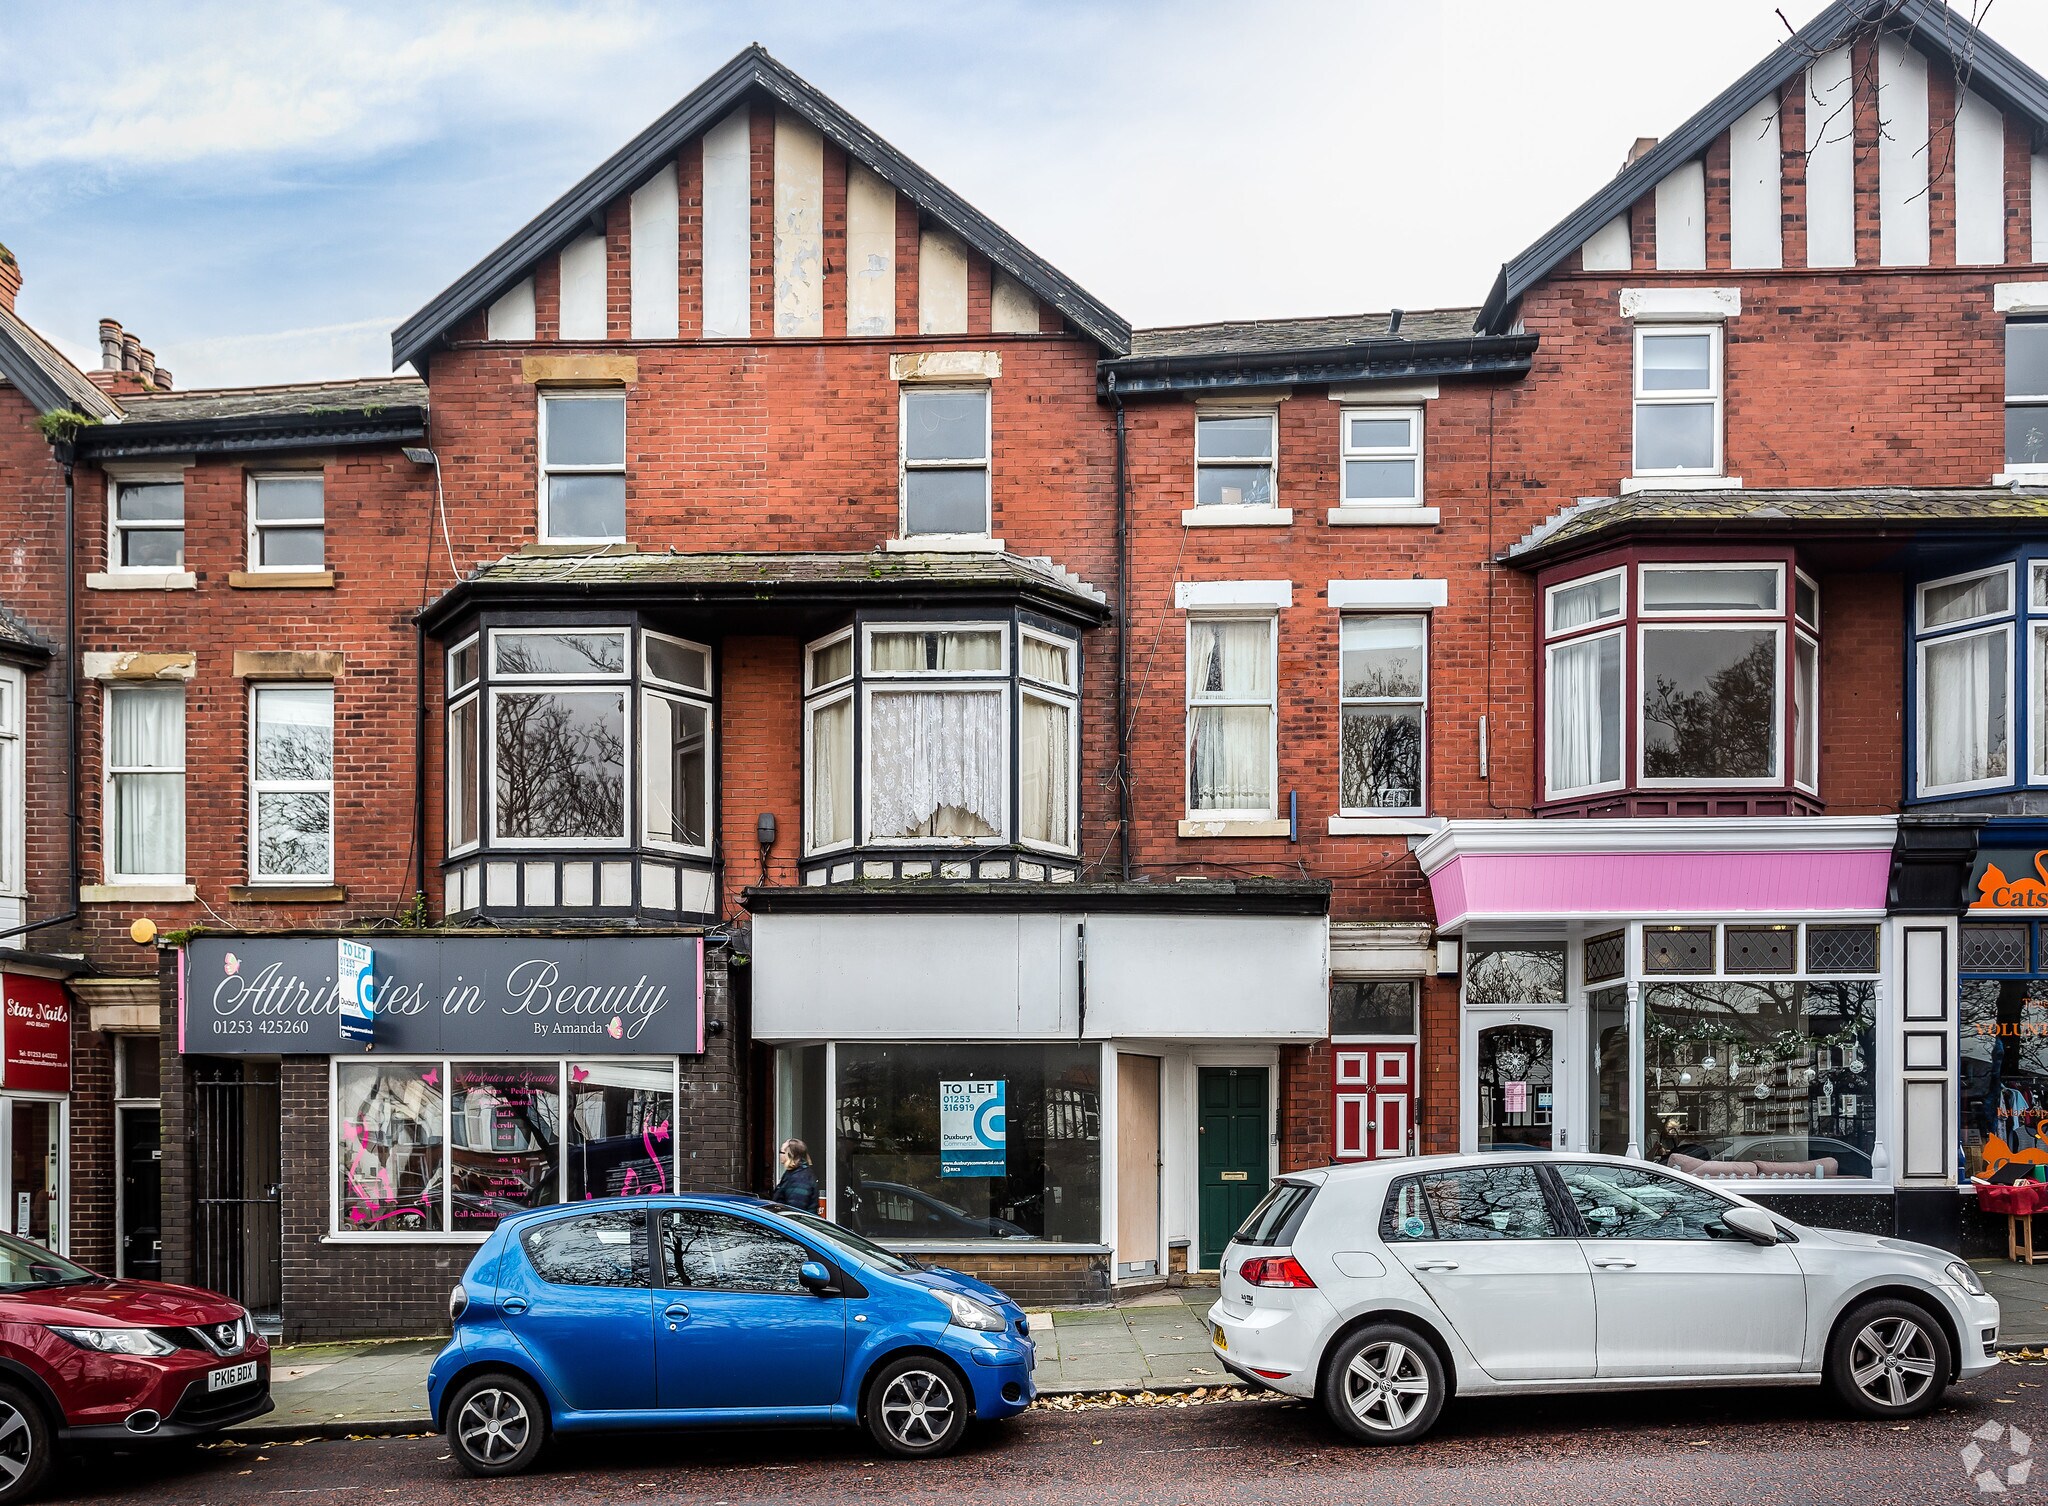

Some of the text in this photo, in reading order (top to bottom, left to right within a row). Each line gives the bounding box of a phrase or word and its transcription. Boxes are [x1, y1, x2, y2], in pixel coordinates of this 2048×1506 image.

[1992, 887, 2048, 907] Cats
[343, 942, 367, 960] TO LET
[442, 975, 487, 1014] in
[502, 959, 669, 1040] Beauty
[7, 998, 68, 1022] Star Nails
[1509, 1012, 1521, 1021] 24
[213, 1020, 309, 1034] 01253 425260
[533, 1022, 603, 1036] By Amanda
[455, 1071, 504, 1083] Attributes
[517, 1070, 557, 1086] Beauty
[943, 1084, 994, 1094] TO LET
[943, 1095, 971, 1103] 01253
[943, 1104, 975, 1112] 316919
[943, 1134, 973, 1142] Duxburys
[454, 1210, 468, 1218] Call
[214, 1364, 253, 1388] PK16 BDX
